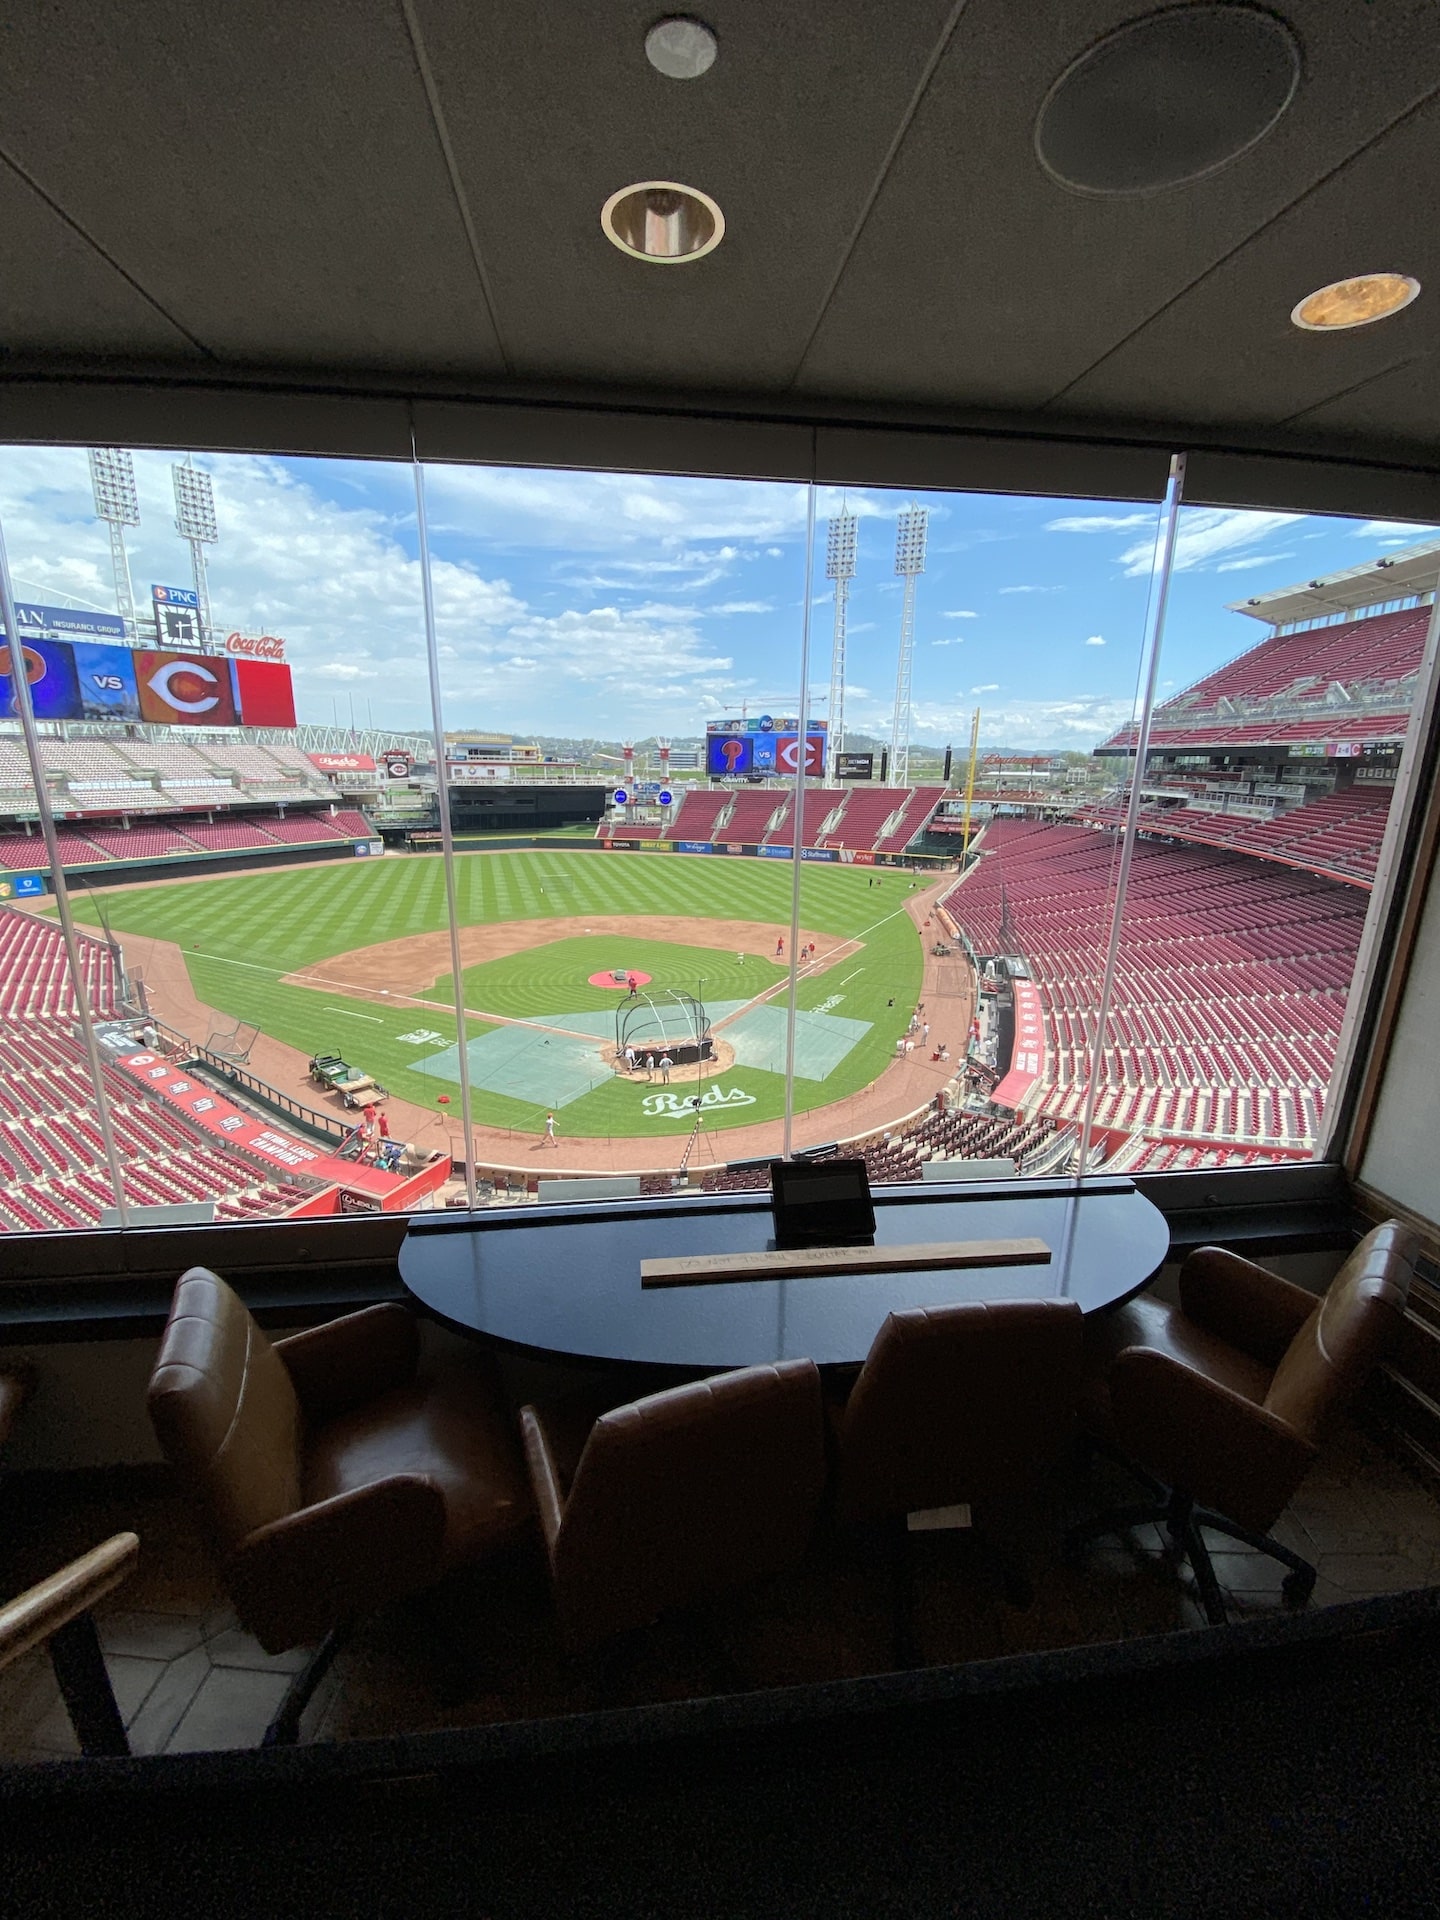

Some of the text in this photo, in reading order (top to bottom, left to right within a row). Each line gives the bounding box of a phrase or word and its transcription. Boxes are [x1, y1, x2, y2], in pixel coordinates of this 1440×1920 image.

[168, 589, 196, 604] PNC
[52, 619, 96, 632] INSURANCE
[97, 624, 121, 634] GROUP
[92, 675, 123, 690] VS
[642, 1085, 757, 1118] Reds
[248, 1137, 303, 1166] CHAMPIONS
[259, 1131, 318, 1161] NATIONAL LEAGUE
